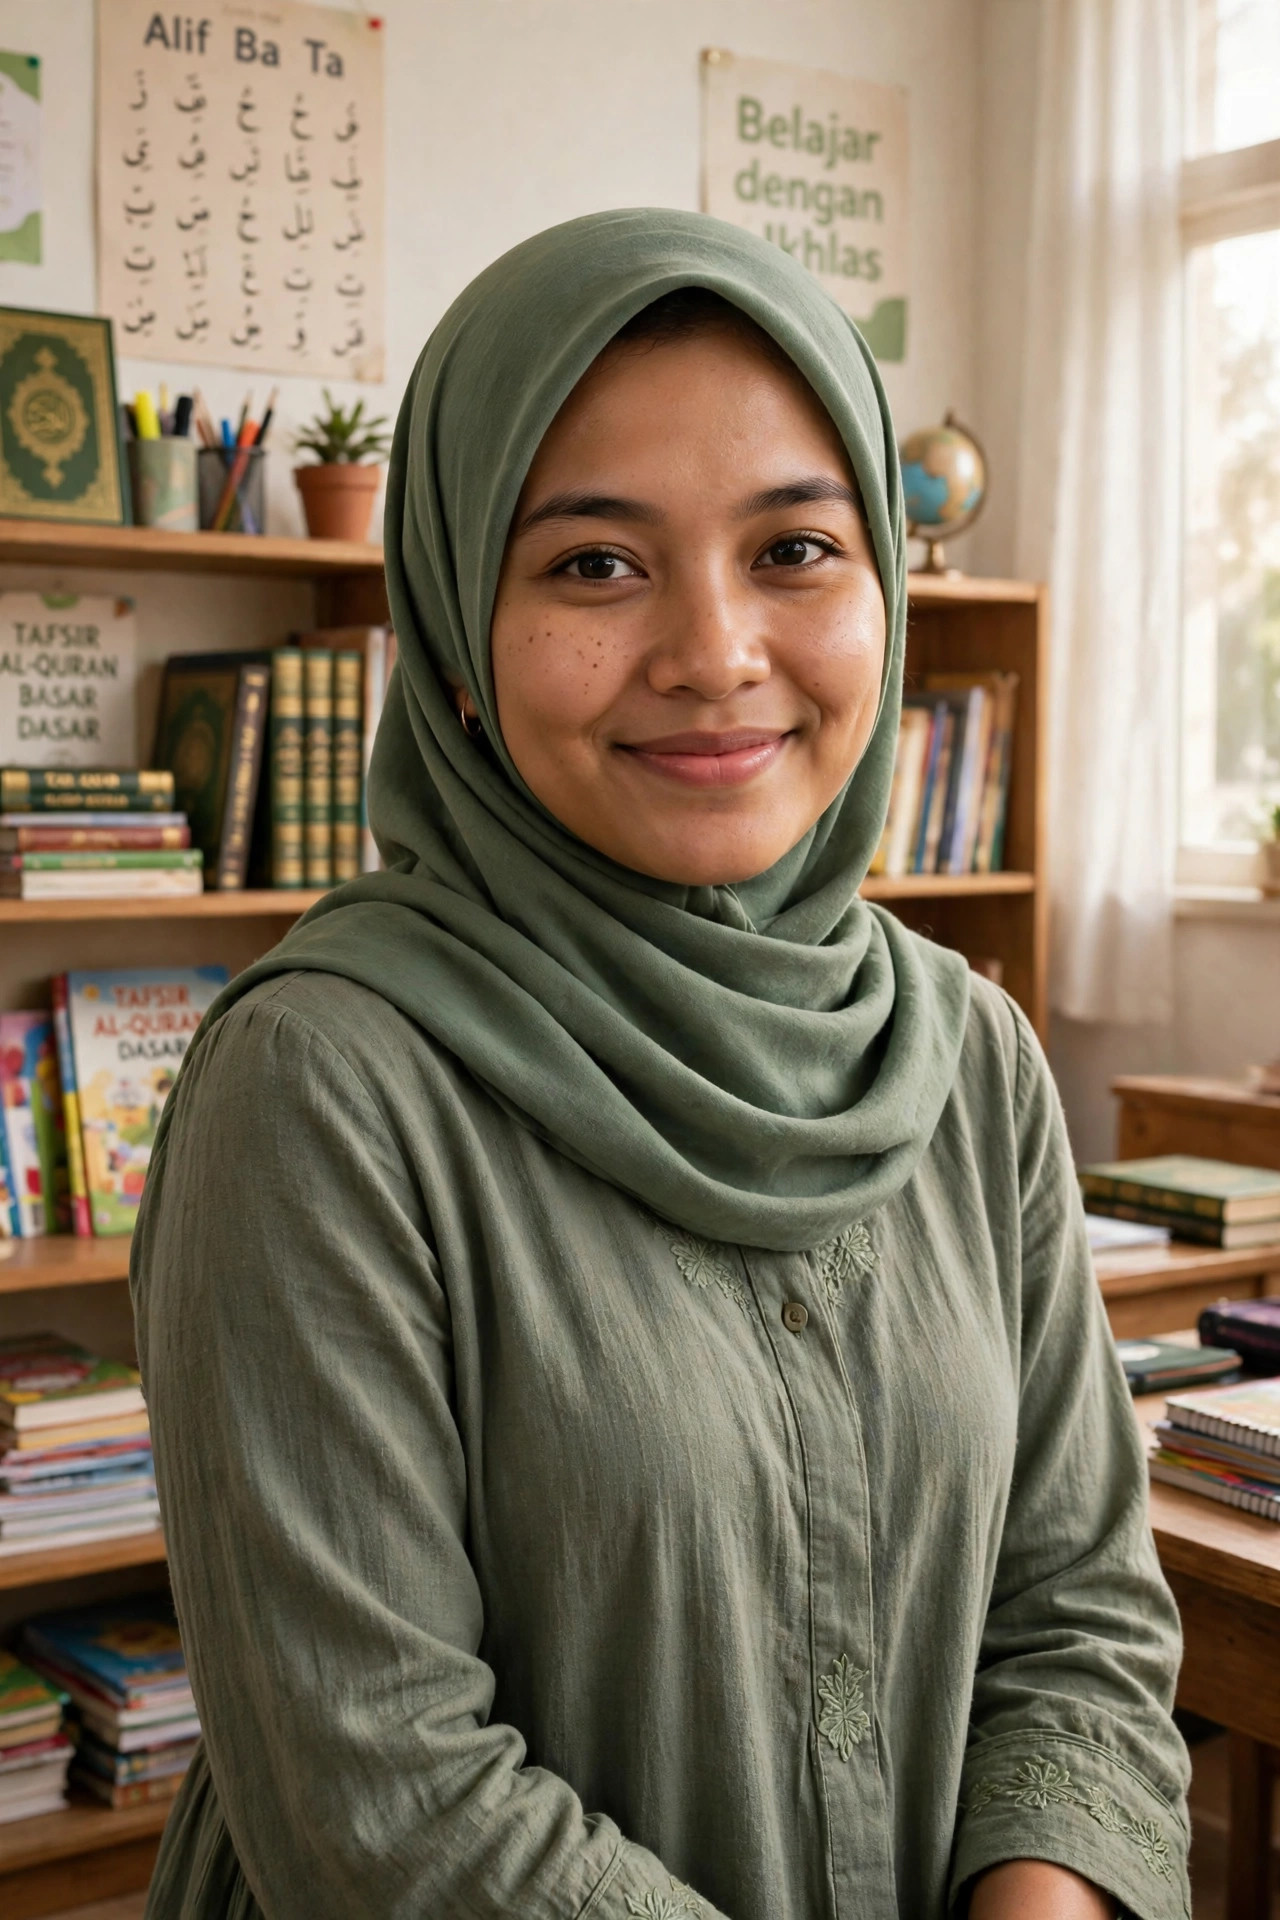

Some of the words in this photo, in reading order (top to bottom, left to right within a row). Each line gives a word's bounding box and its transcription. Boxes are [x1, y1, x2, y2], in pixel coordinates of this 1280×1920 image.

[143, 12, 211, 54] Alif
[234, 27, 280, 68] Ba
[304, 38, 344, 78] Ta
[737, 95, 882, 169] Belajar
[734, 158, 883, 226] dengan
[13, 622, 101, 648] TAFSIR
[0, 652, 118, 678] AL-QURAN
[17, 716, 101, 742] DASAR
